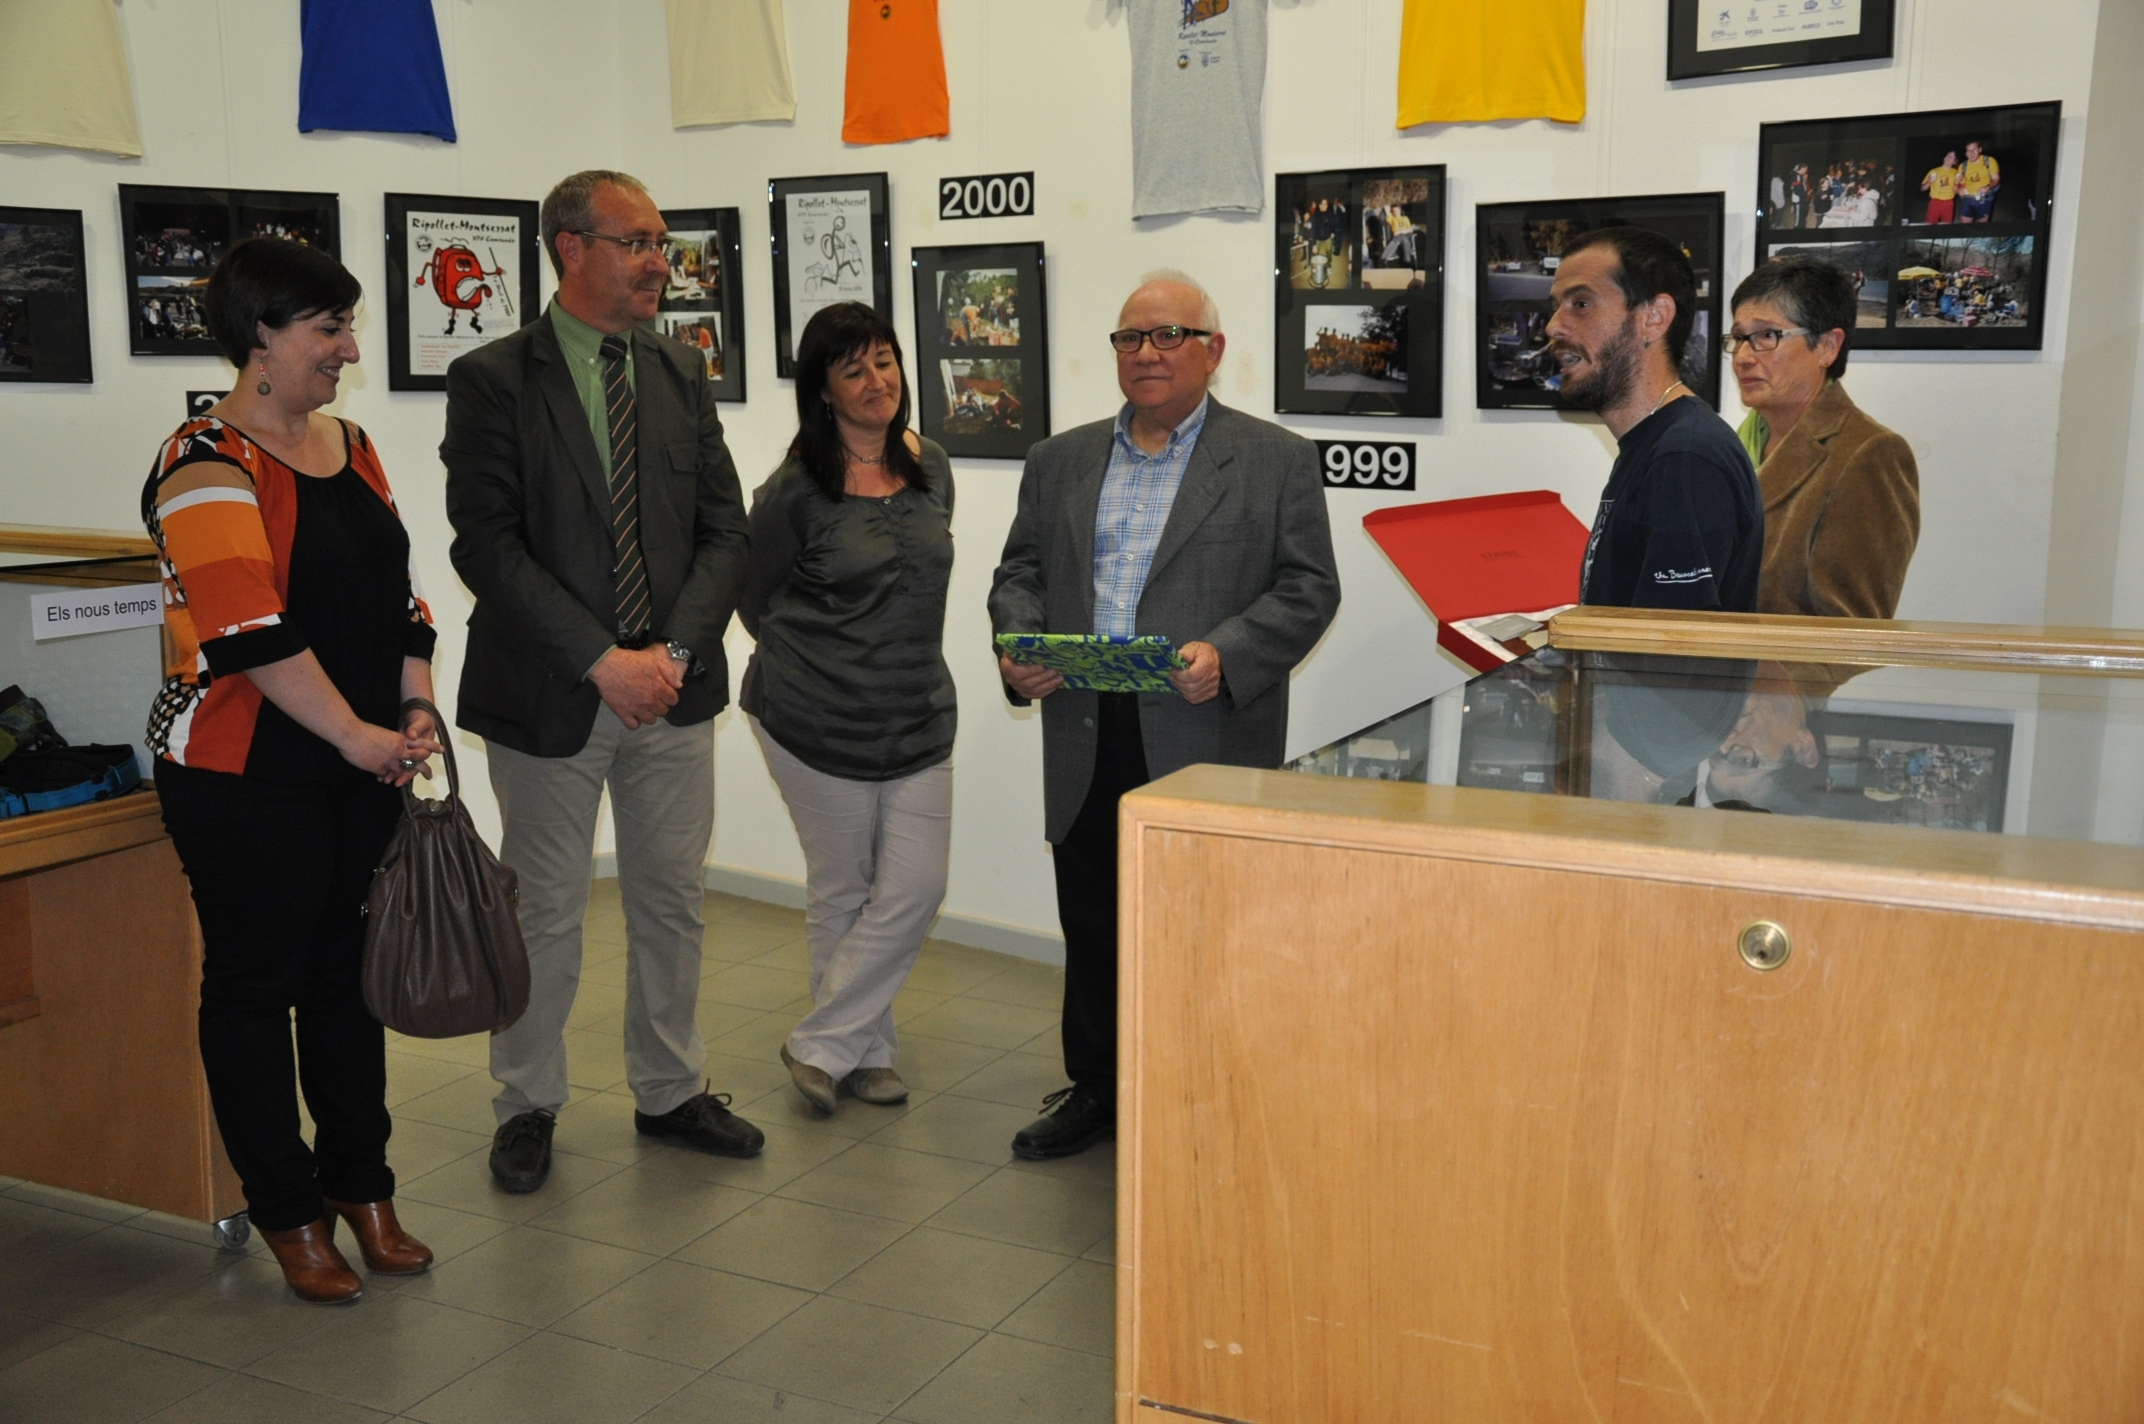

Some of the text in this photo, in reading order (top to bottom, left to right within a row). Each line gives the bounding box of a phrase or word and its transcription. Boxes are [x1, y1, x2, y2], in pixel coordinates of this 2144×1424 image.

[942, 176, 1030, 217] 2000
[1325, 444, 1409, 486] 999
[47, 599, 157, 622] Els nous temps
